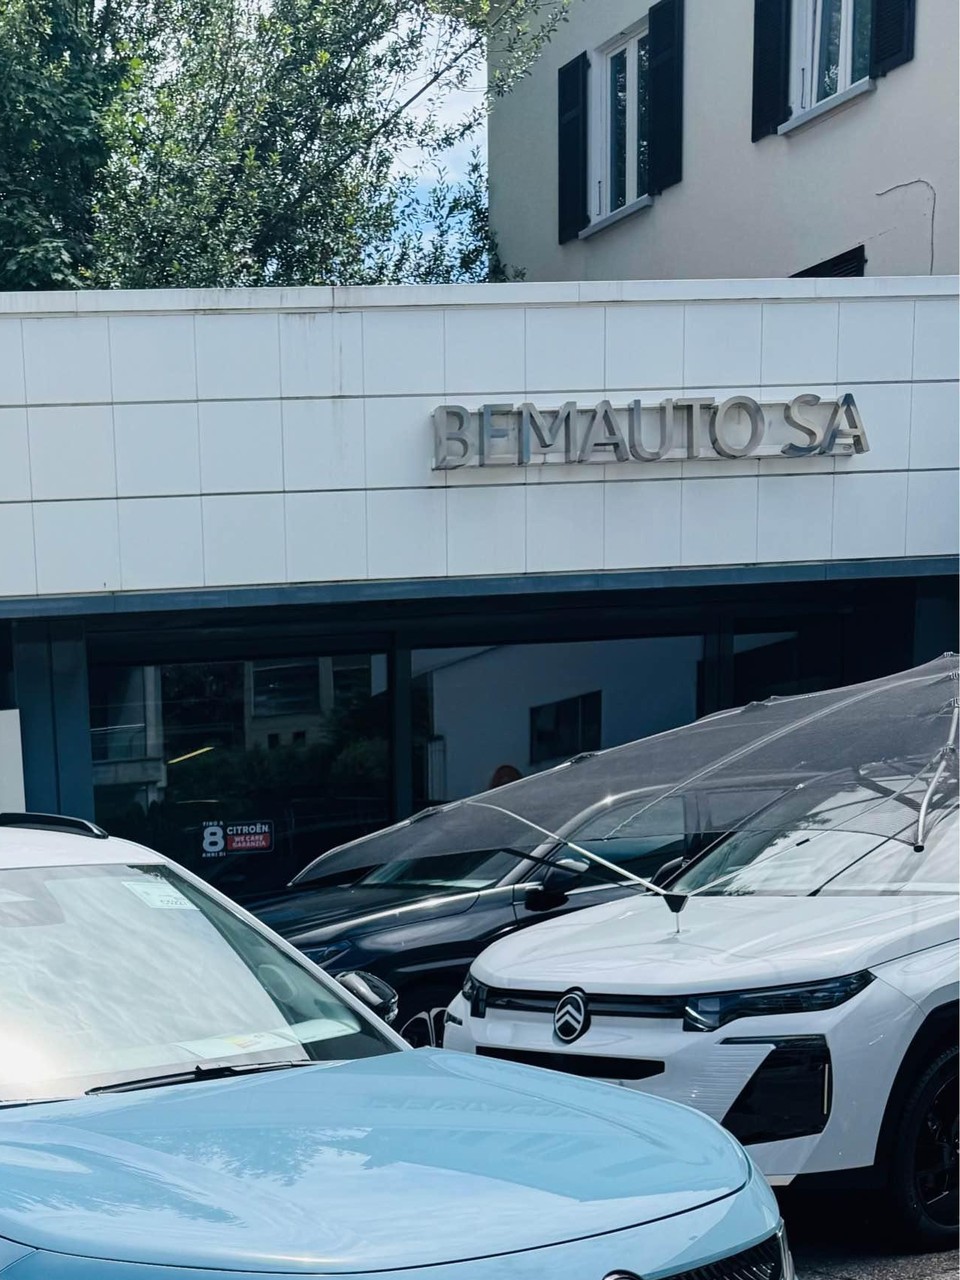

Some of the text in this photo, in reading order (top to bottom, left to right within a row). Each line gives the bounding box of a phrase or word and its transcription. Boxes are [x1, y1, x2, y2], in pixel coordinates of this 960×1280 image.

[431, 393, 870, 471] BEMAUTO SA
[203, 826, 225, 852] 8
[227, 823, 269, 834] CITROËN
